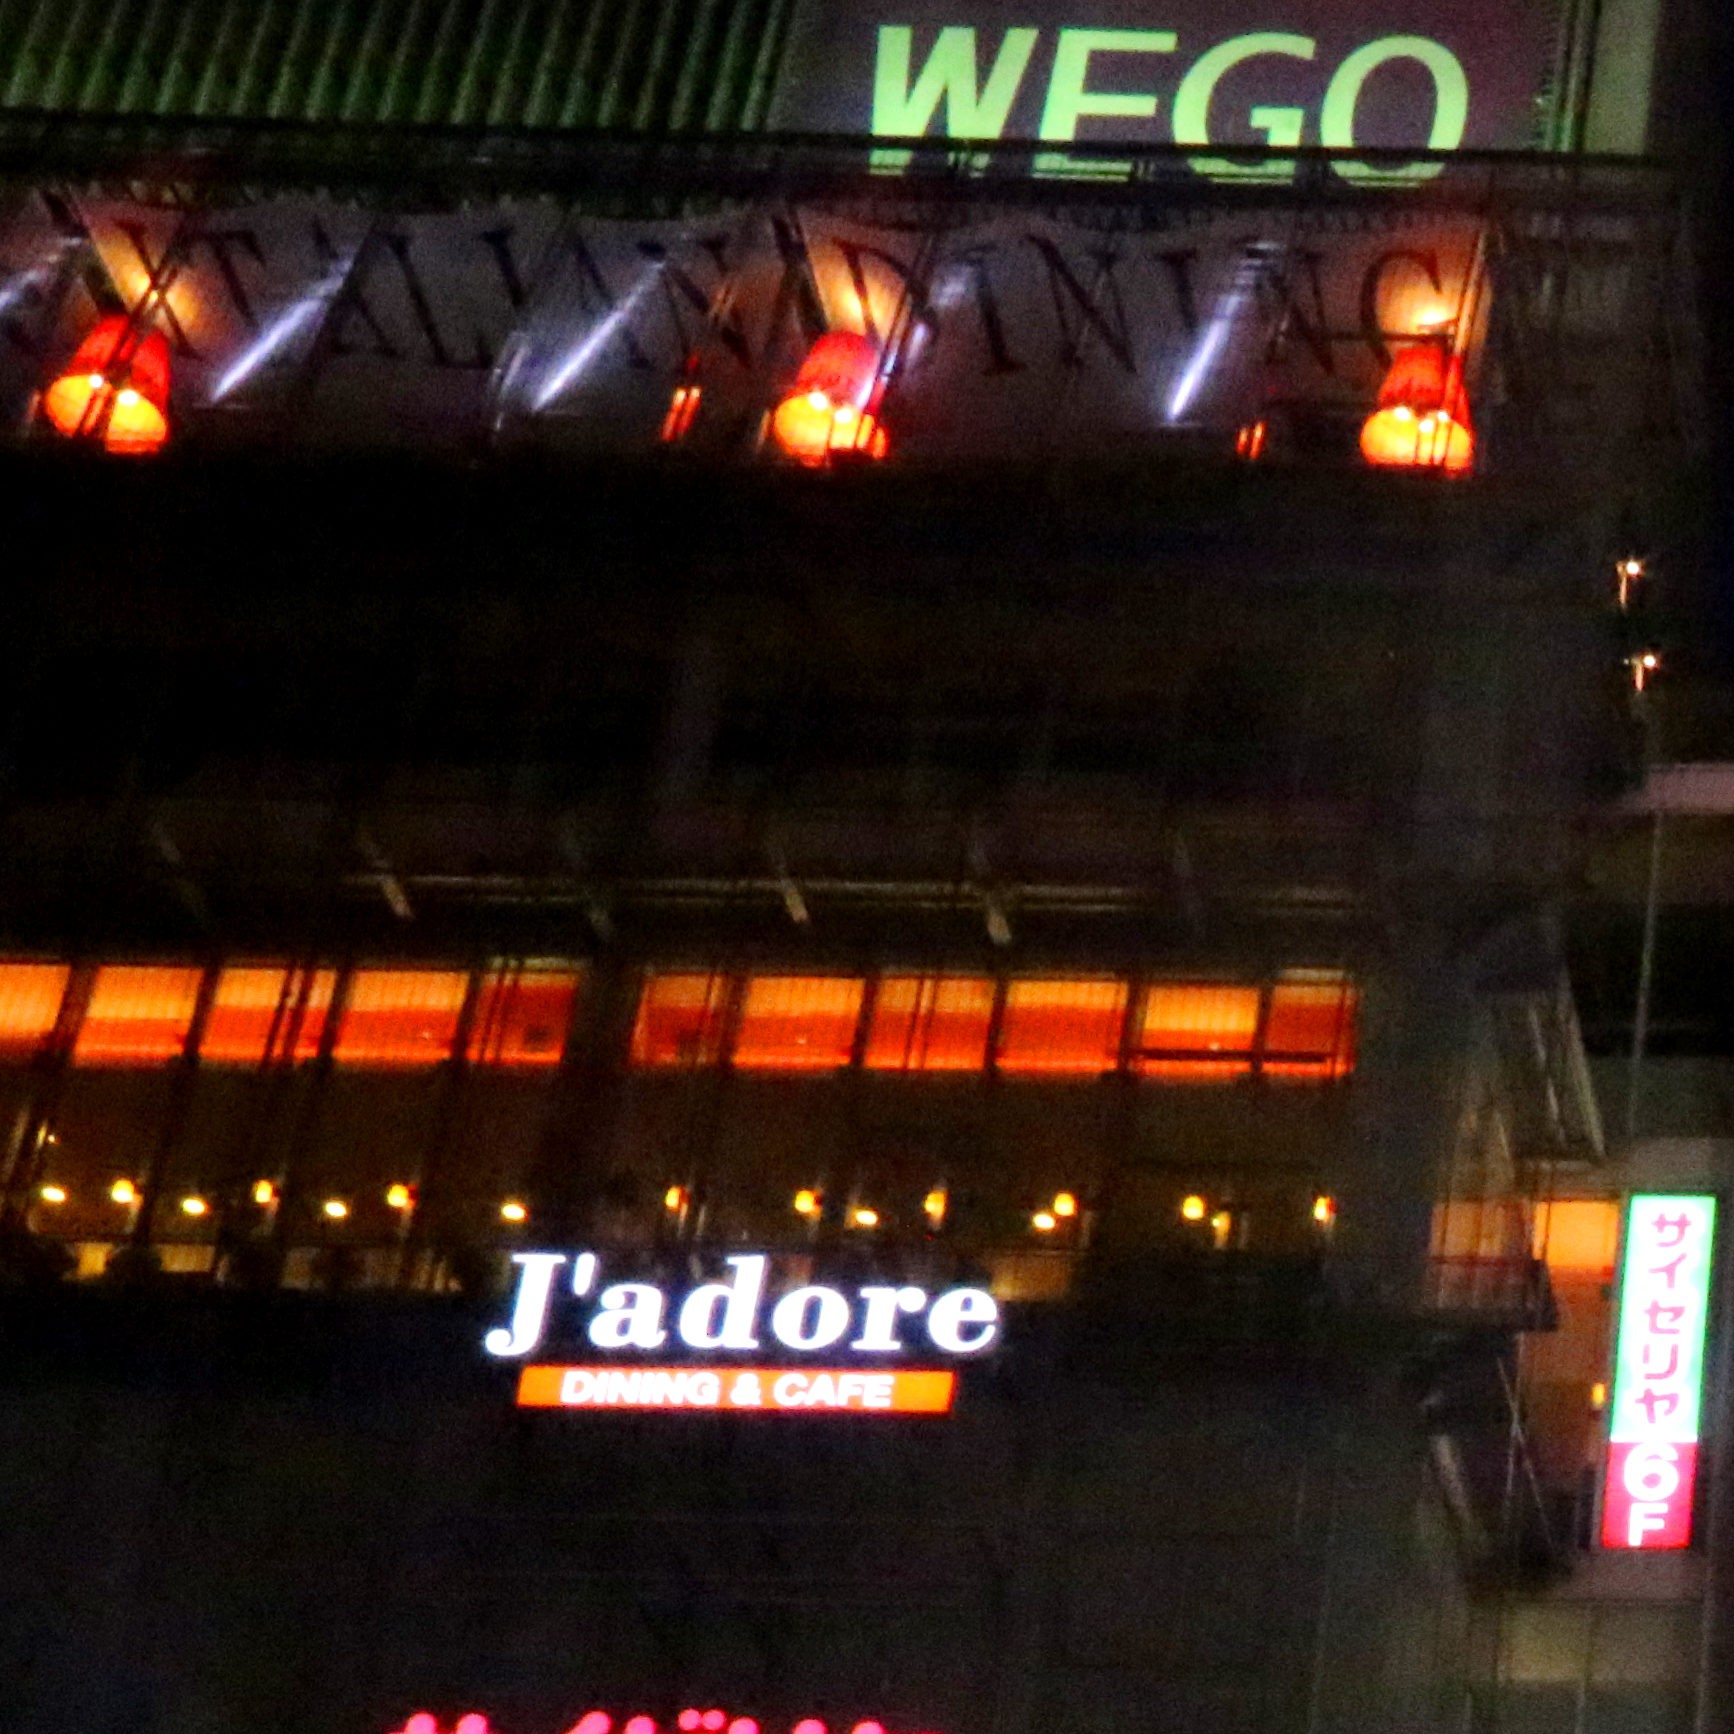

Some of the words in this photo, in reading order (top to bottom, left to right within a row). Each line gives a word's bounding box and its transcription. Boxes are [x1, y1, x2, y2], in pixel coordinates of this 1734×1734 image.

[866, 23, 1470, 188] WEGO
[482, 1252, 999, 1357] J'adore
[560, 1370, 721, 1405] DINING
[731, 1373, 762, 1406] &
[773, 1374, 895, 1408] CAFE
[1623, 1442, 1680, 1547] 6F
